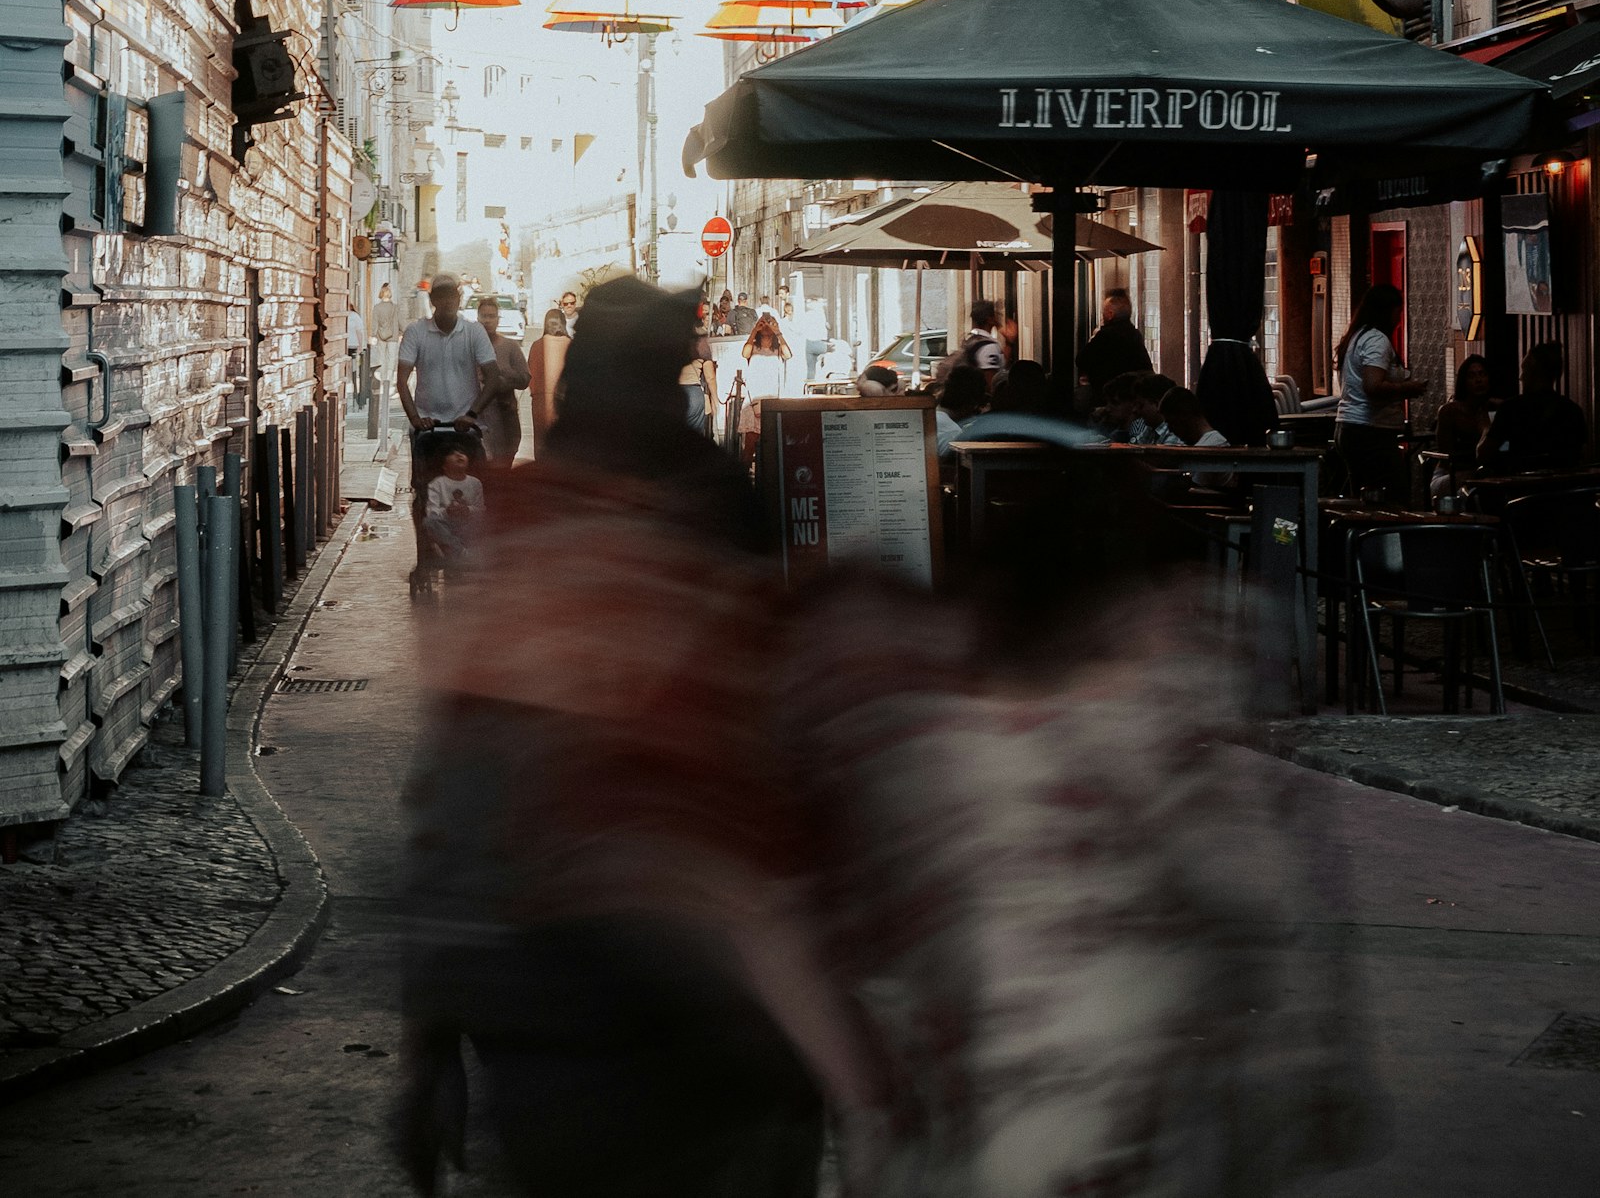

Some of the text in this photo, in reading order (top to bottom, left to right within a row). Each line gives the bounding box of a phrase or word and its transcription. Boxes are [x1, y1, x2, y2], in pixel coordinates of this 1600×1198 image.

[999, 88, 1292, 132] LIVERPOOL
[876, 471, 883, 479] TO
[791, 497, 819, 520] ME
[793, 522, 819, 546] NU
